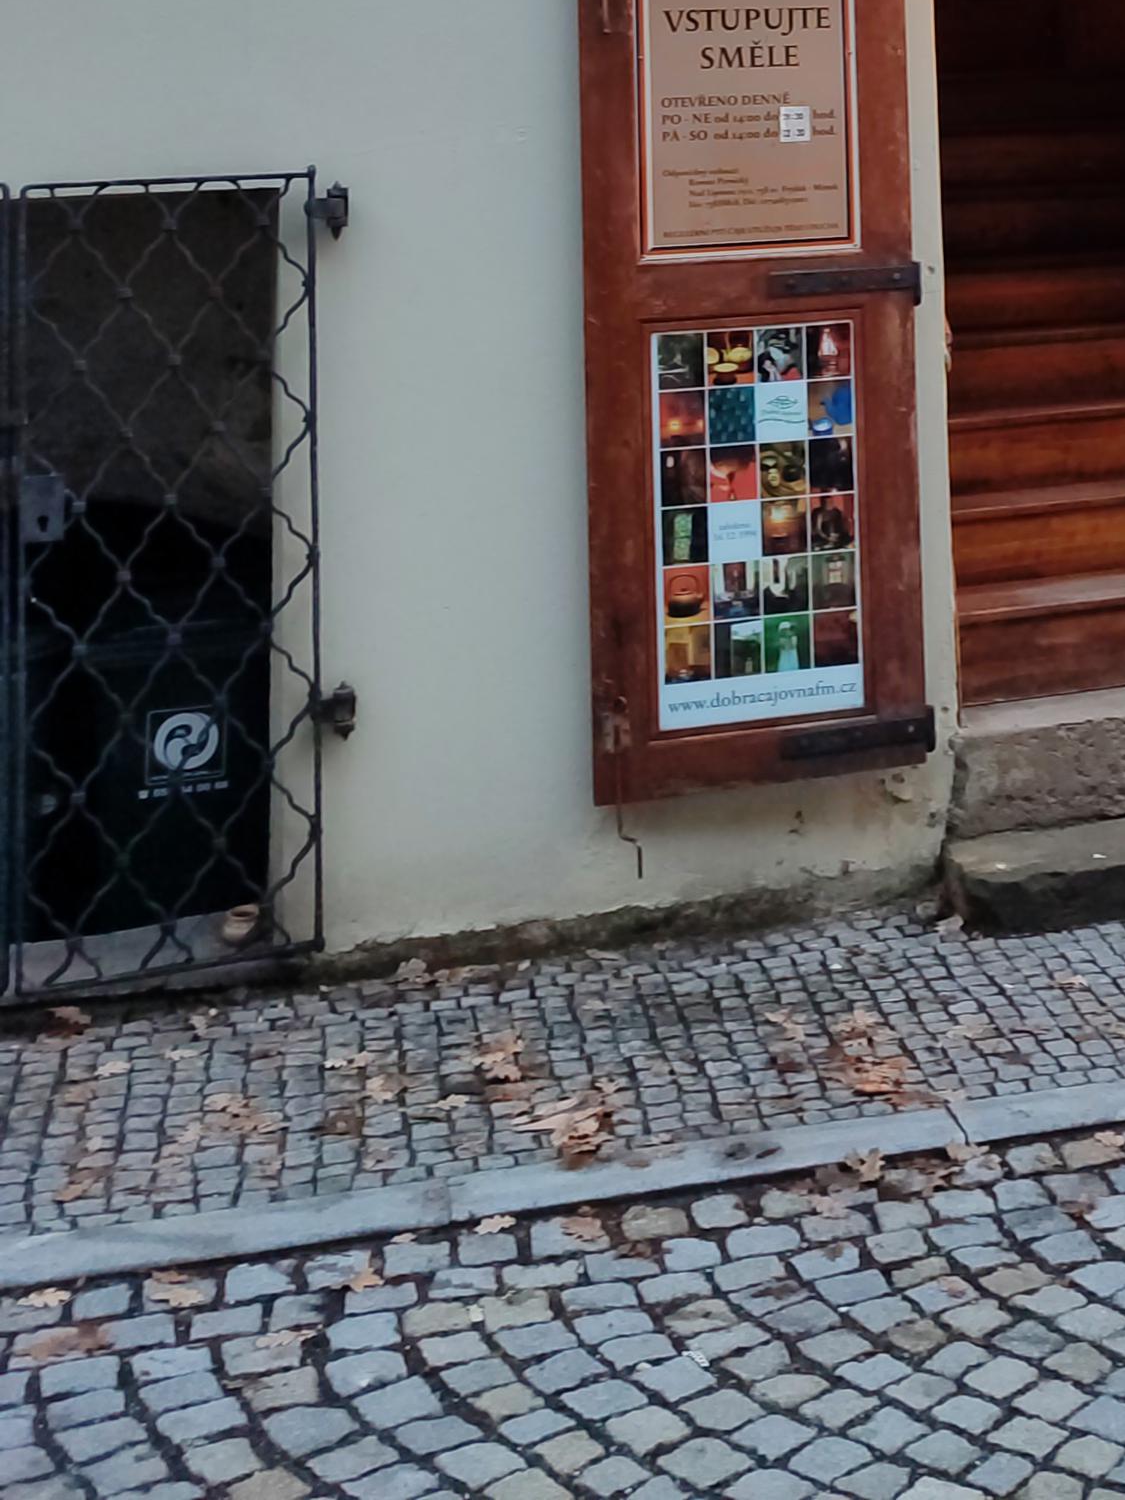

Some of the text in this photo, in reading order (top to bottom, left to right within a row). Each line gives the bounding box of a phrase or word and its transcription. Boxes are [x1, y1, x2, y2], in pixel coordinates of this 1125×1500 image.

[662, 6, 832, 37] VSTUPUJTE
[700, 40, 800, 69] SMĚLE
[661, 95, 738, 109] OTEVŘENO
[662, 114, 682, 125] PO
[692, 112, 711, 124] NE
[688, 130, 708, 141] SO
[668, 680, 857, 713] www.dobracajovnafm.cz
